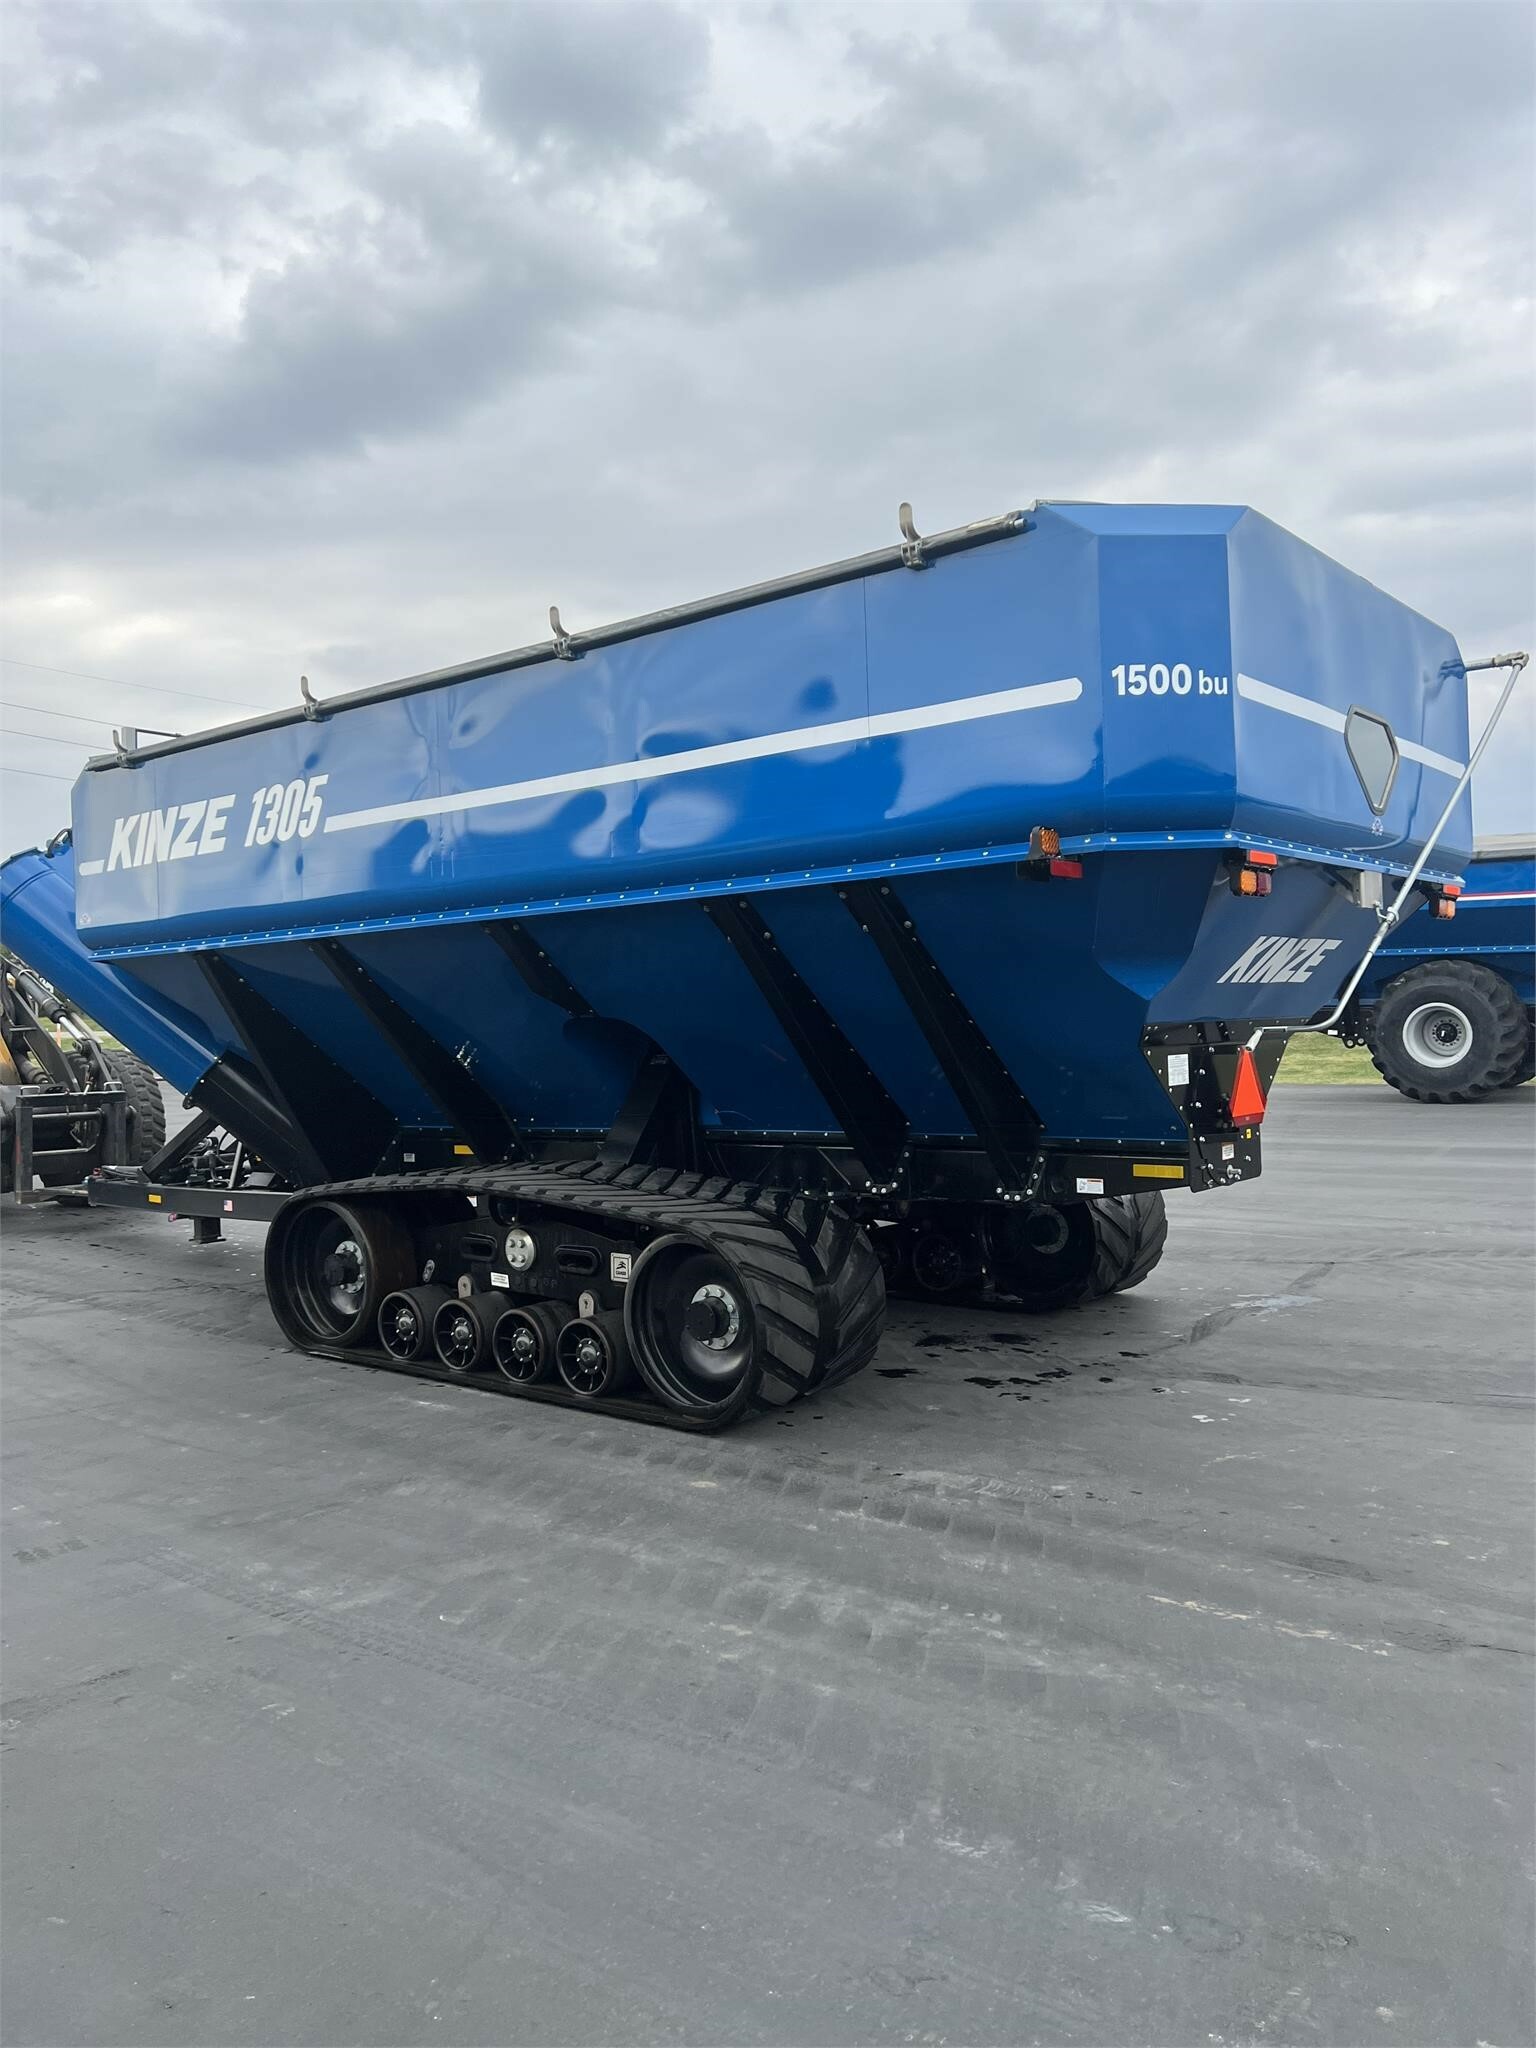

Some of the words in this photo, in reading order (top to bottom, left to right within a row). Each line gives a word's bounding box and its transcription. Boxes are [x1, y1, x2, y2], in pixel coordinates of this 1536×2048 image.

[1111, 663, 1193, 696] 1500
[1198, 669, 1228, 695] bu
[107, 794, 237, 872] KINZE
[244, 774, 329, 847] 1305
[1216, 935, 1344, 984] KINZE
